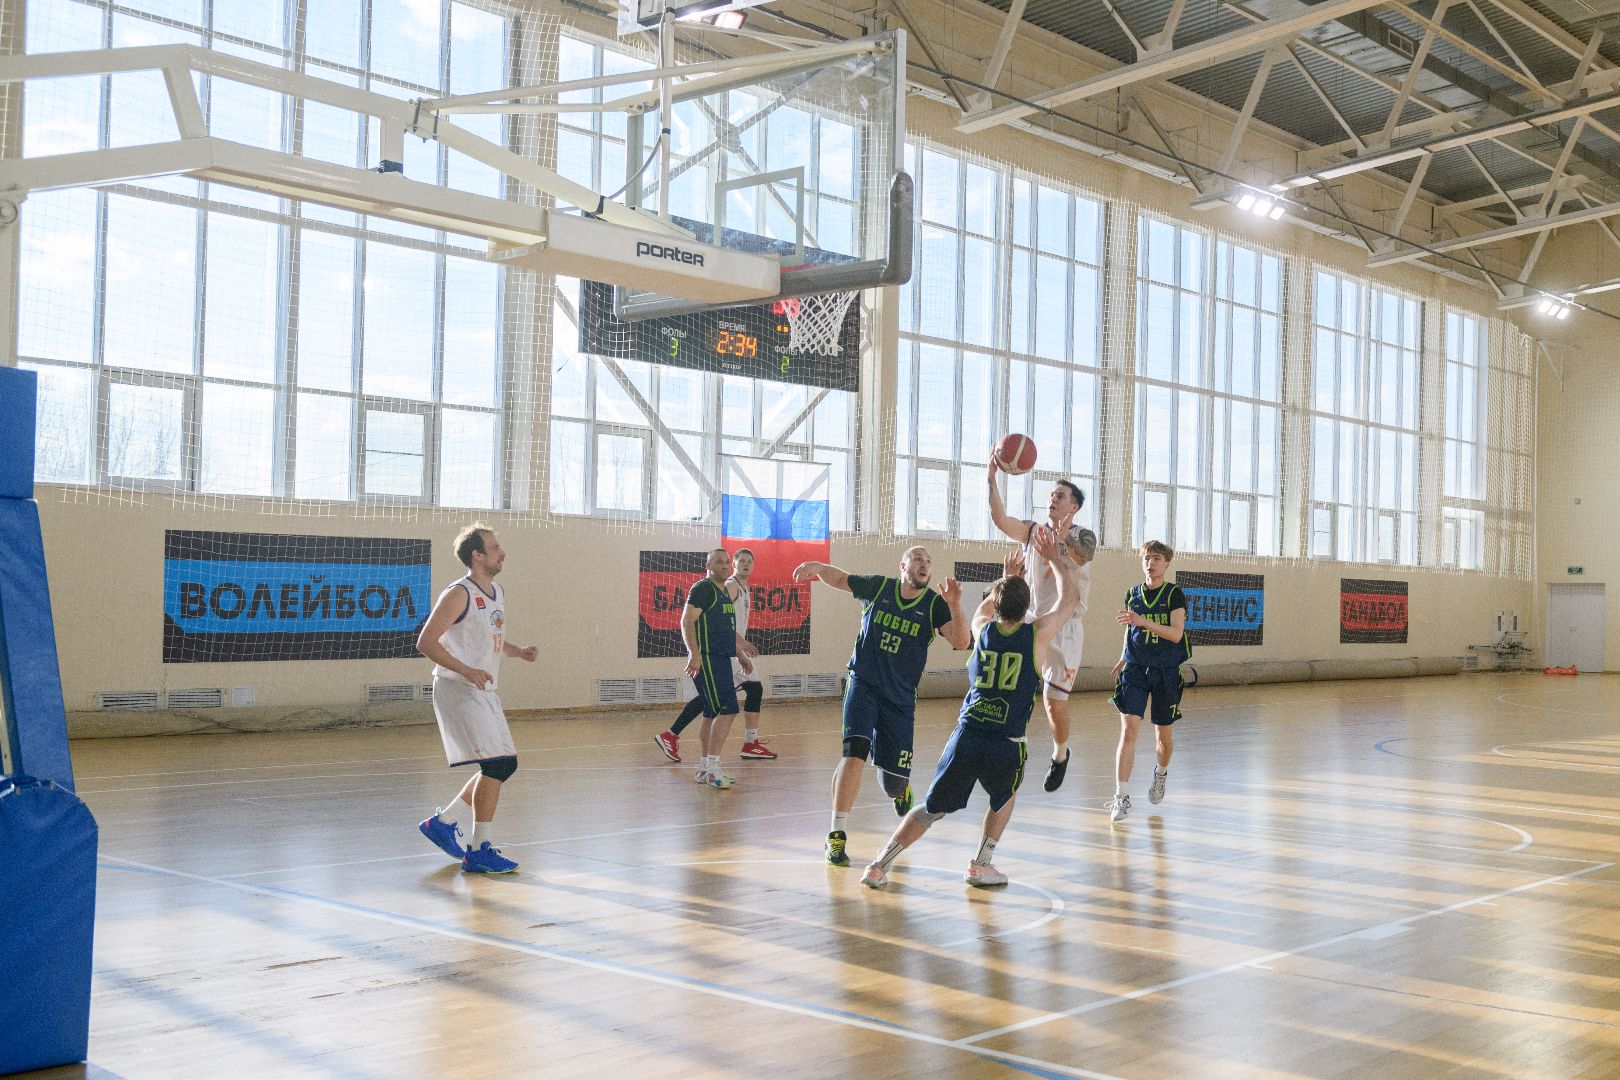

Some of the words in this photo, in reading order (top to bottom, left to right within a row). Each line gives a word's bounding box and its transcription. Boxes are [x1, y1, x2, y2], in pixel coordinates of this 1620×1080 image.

[661, 326, 687, 339] ФОЛЫ
[718, 320, 746, 332] ВРЕМЯ
[670, 337, 679, 357] 3
[716, 330, 757, 358] 2:34
[180, 574, 418, 619] ВОЛЕЙБОЛ
[653, 586, 802, 612] БАБОЛ
[879, 631, 902, 654] 23
[975, 650, 1023, 691] 30
